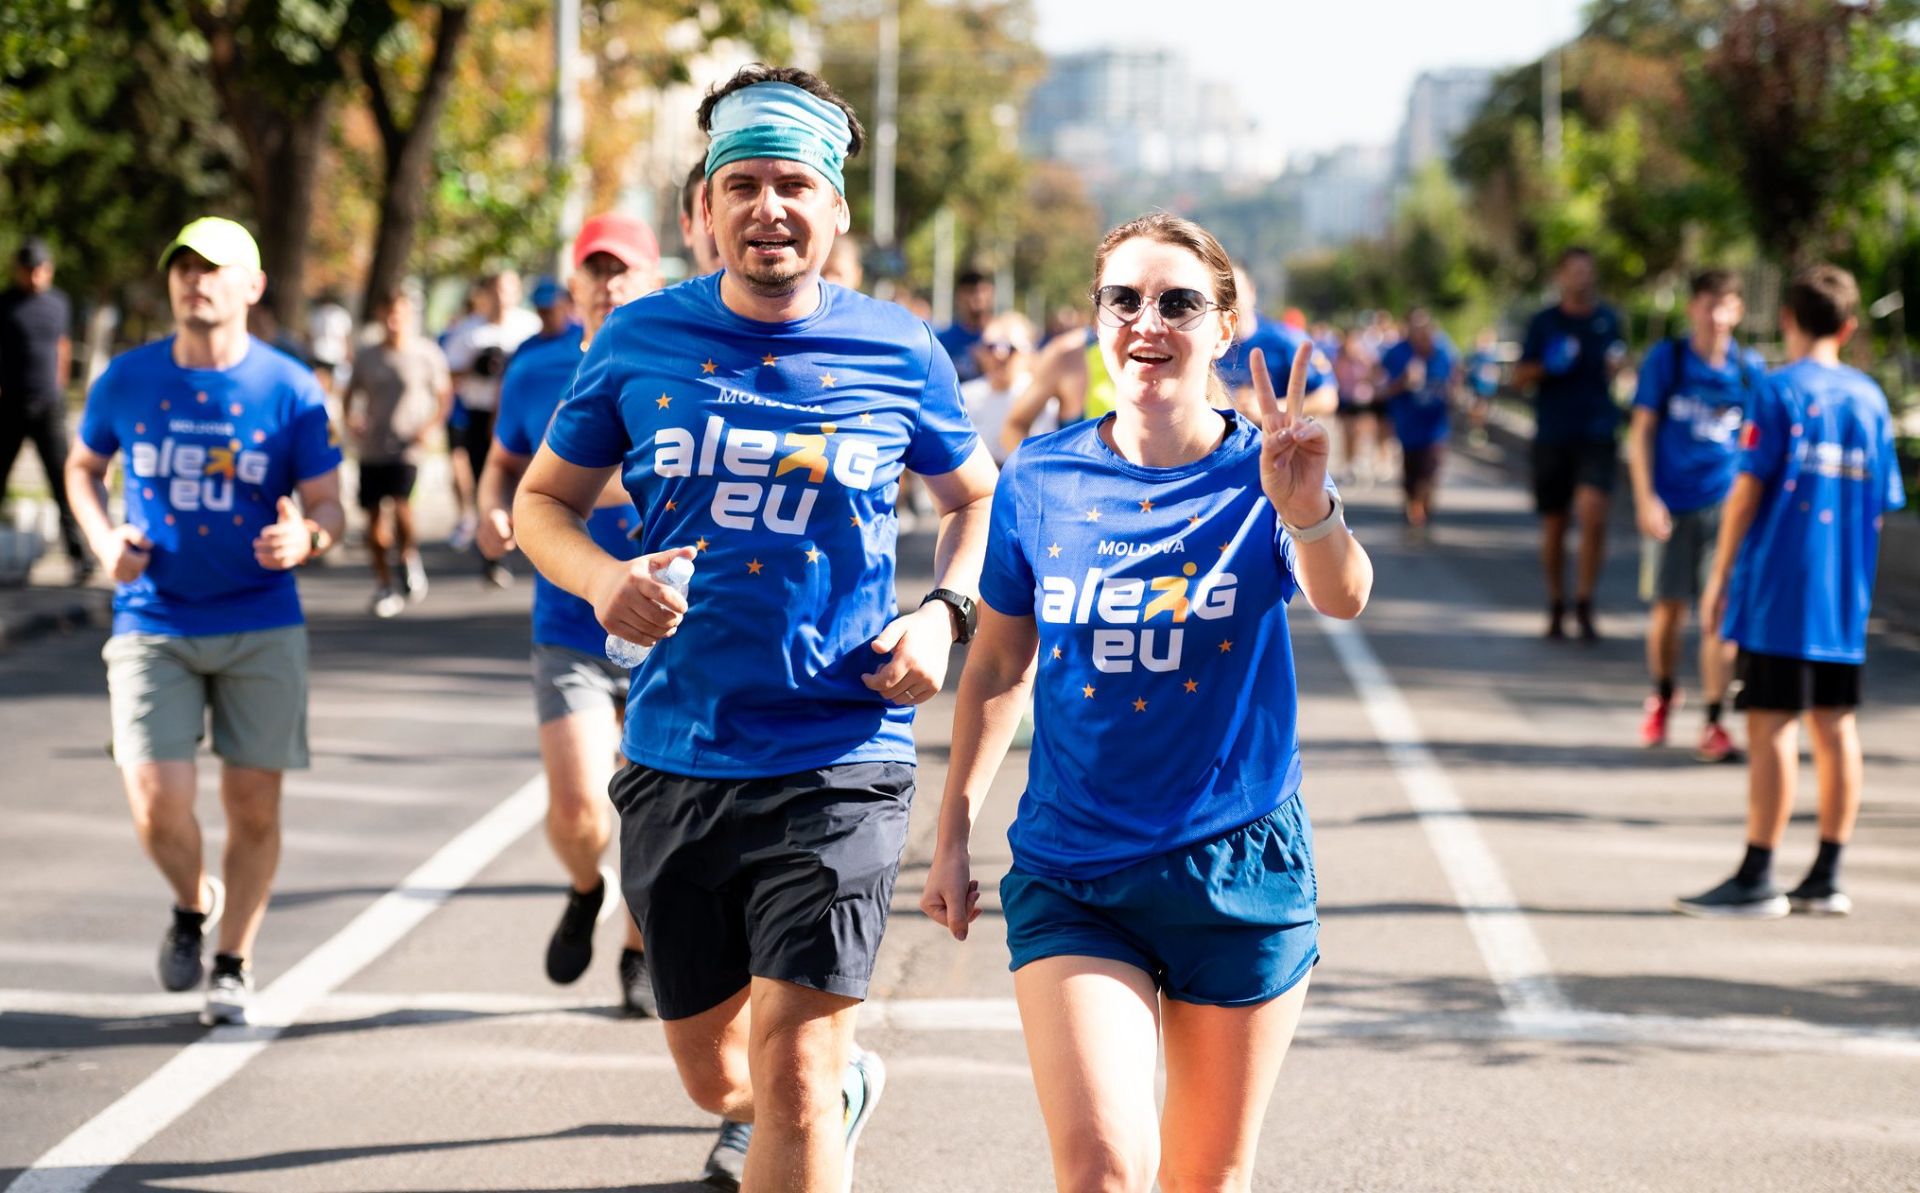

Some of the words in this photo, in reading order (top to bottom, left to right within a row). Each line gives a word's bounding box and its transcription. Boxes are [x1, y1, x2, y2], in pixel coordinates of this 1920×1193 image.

[170, 478, 233, 511] eu
[711, 481, 819, 535] eu
[1097, 540, 1185, 556] MOLDOVA
[1092, 629, 1184, 673] eu
